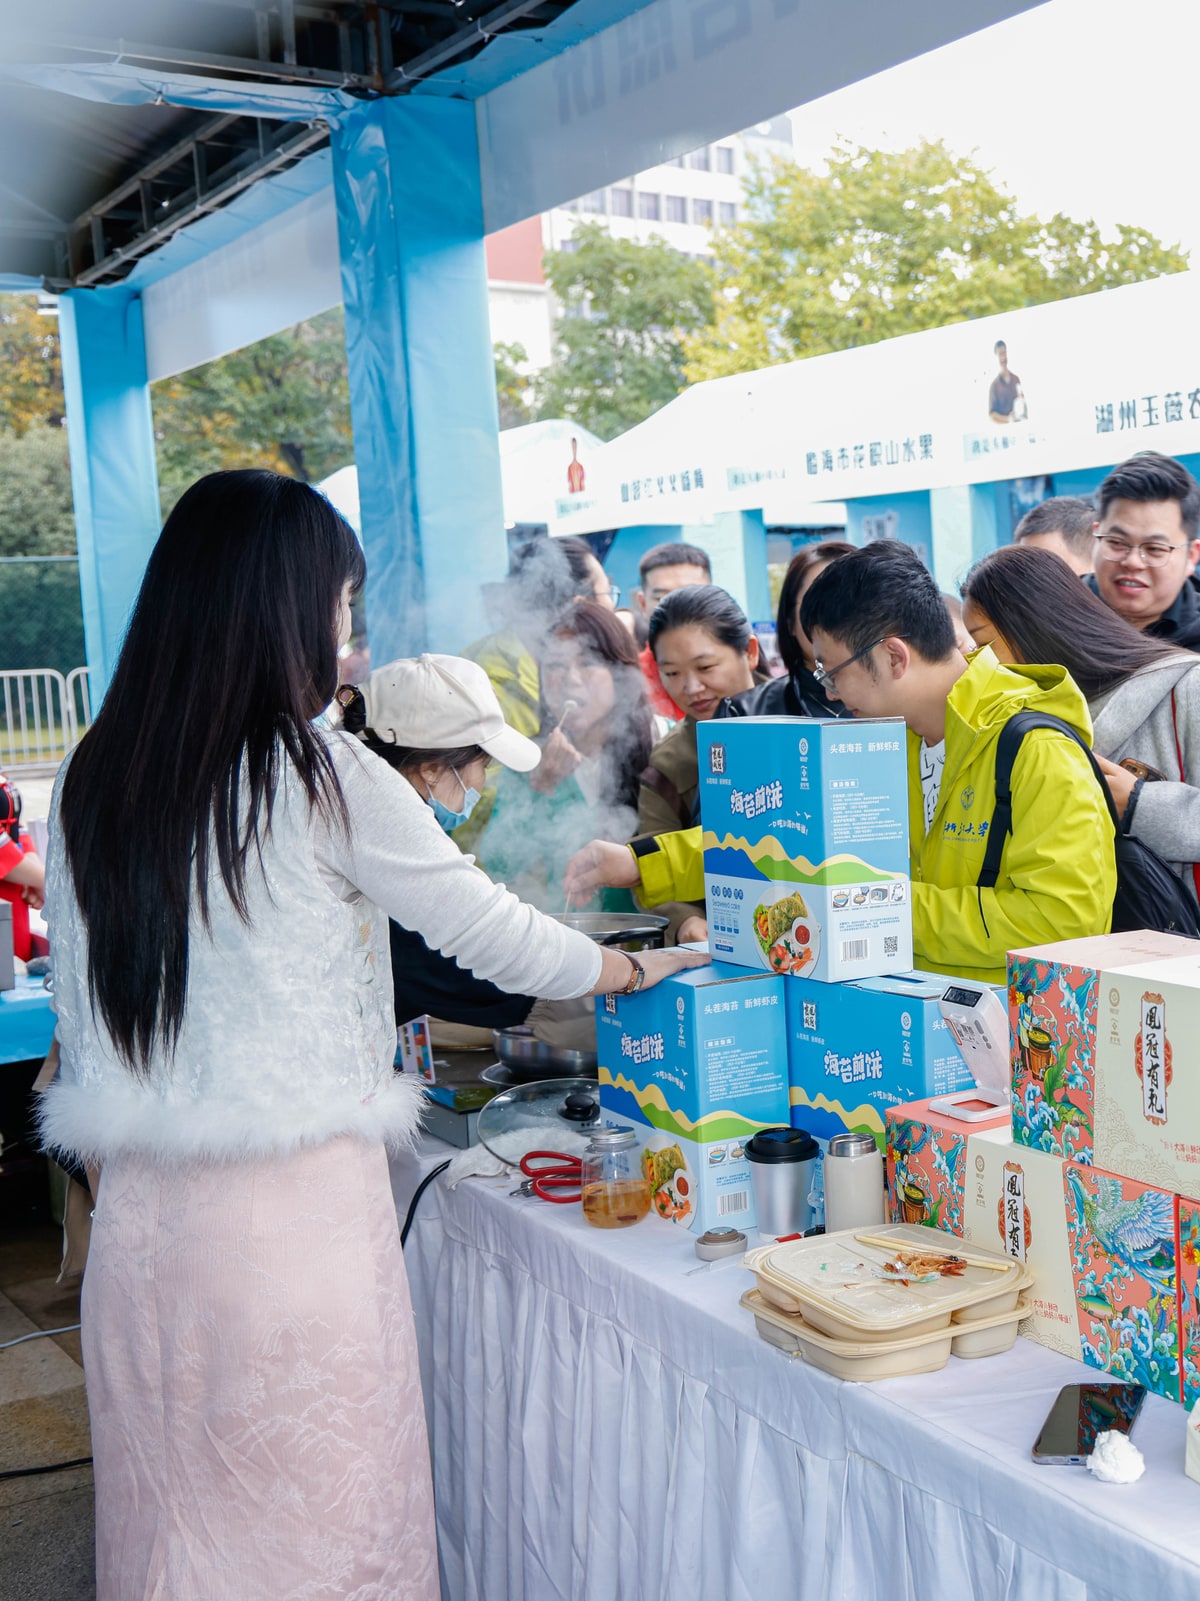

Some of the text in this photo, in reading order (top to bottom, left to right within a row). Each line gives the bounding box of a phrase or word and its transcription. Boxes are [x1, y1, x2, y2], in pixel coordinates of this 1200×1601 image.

[731, 780, 783, 819] 海苔煎饼
[703, 995, 779, 1015] 头茬海苔 新鲜虾皮
[621, 1032, 664, 1064] 海苔煎饼
[824, 1050, 883, 1083] 海苔煎饼
